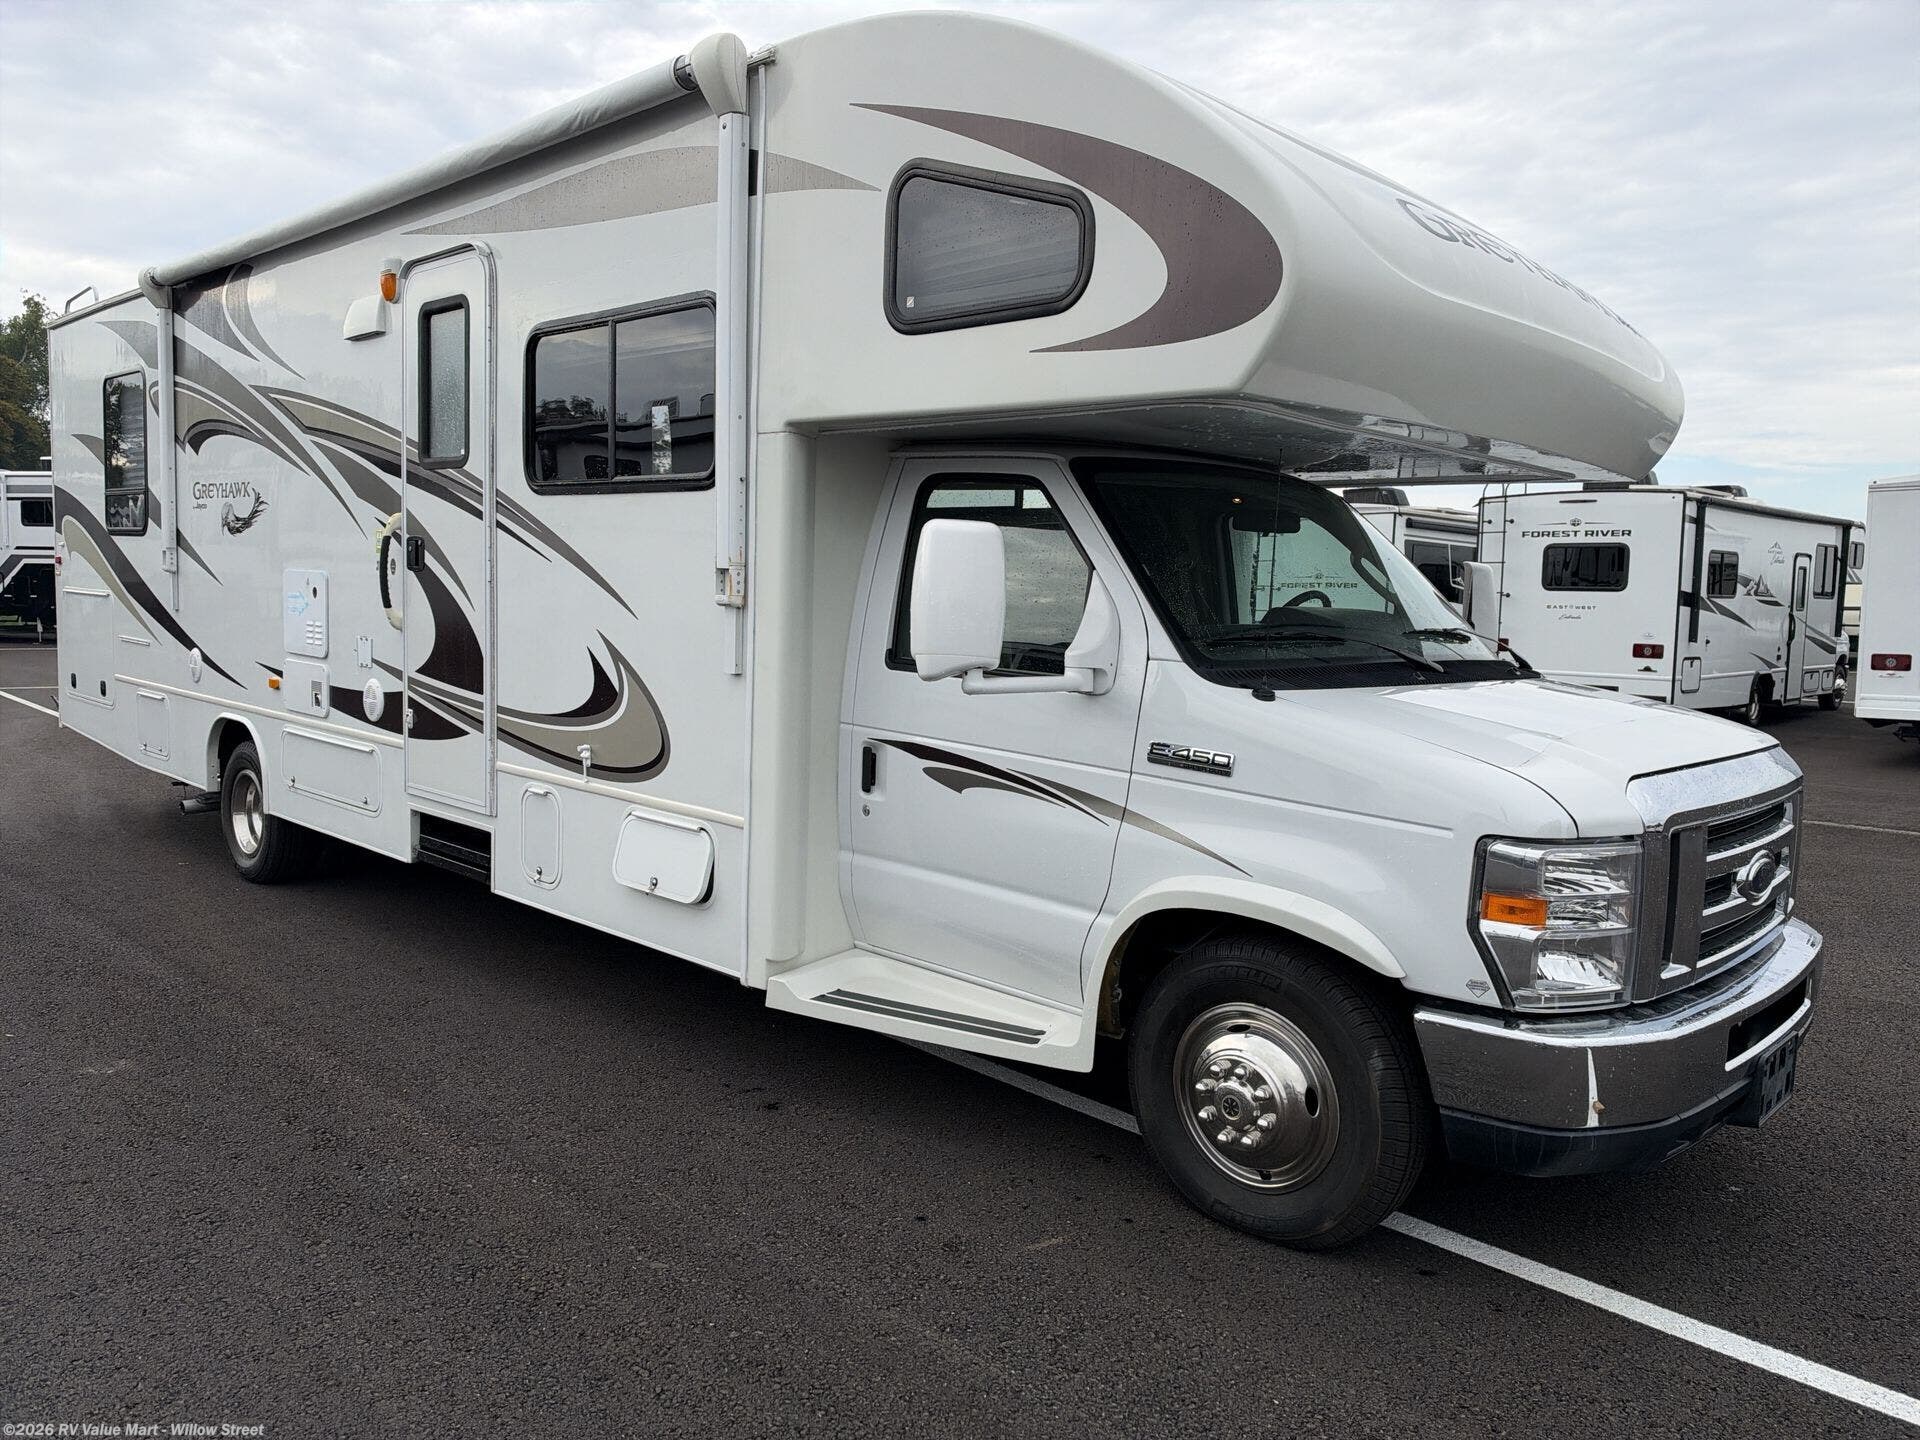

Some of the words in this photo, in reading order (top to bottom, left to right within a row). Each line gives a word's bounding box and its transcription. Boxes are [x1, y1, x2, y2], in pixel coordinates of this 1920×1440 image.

[192, 481, 250, 500] GREYHAWK
[1521, 530, 1580, 538] FOREST
[1584, 529, 1632, 537] RIVER
[1149, 741, 1232, 768] E-450
